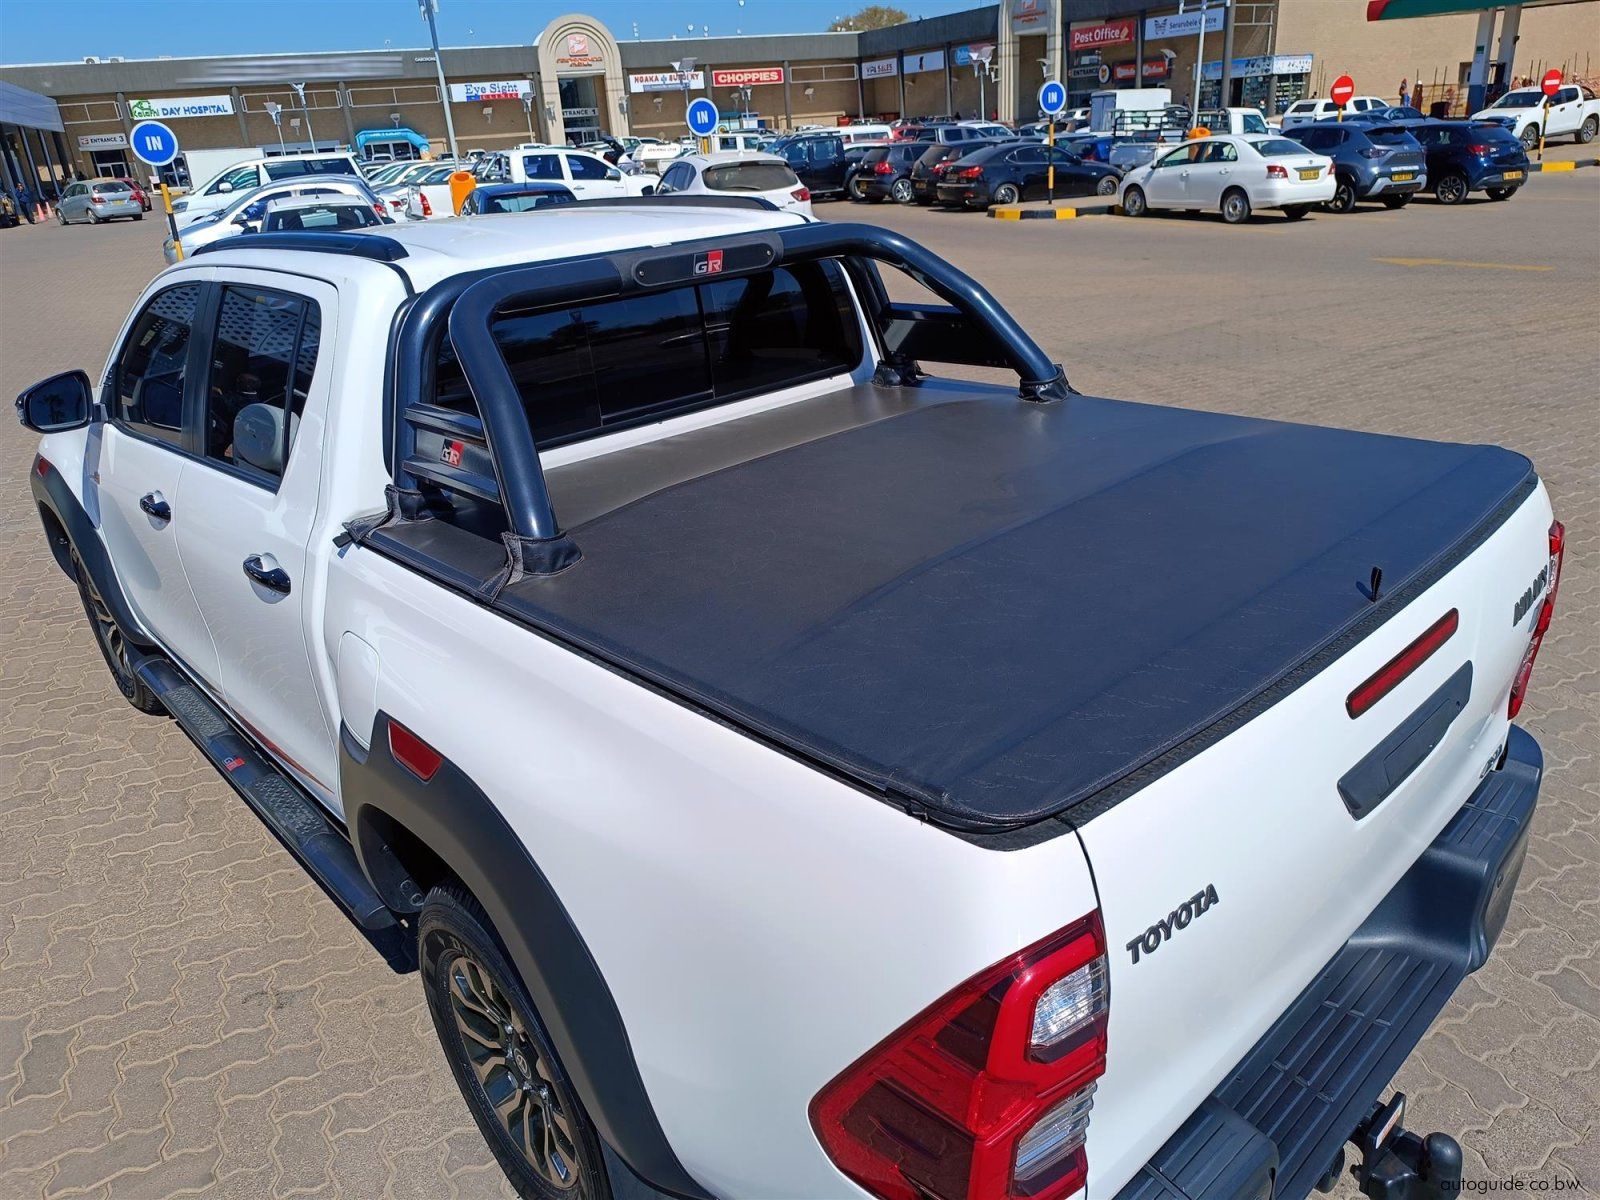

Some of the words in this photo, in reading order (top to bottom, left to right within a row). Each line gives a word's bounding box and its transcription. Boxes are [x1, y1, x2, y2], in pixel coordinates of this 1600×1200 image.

[1075, 32, 1092, 43] Post
[1094, 28, 1120, 40] Office
[718, 72, 779, 83] CHOPPIES
[466, 84, 487, 96] Eye
[489, 82, 518, 94] Sight
[1048, 92, 1058, 104] IN
[161, 107, 180, 116] DAY
[183, 104, 228, 115] HOSPITAL
[696, 110, 709, 124] IN
[118, 135, 125, 143] 3
[145, 135, 164, 151] IN
[695, 259, 721, 274] GR
[441, 447, 460, 466] GR
[1126, 883, 1220, 965] TOYOTA
